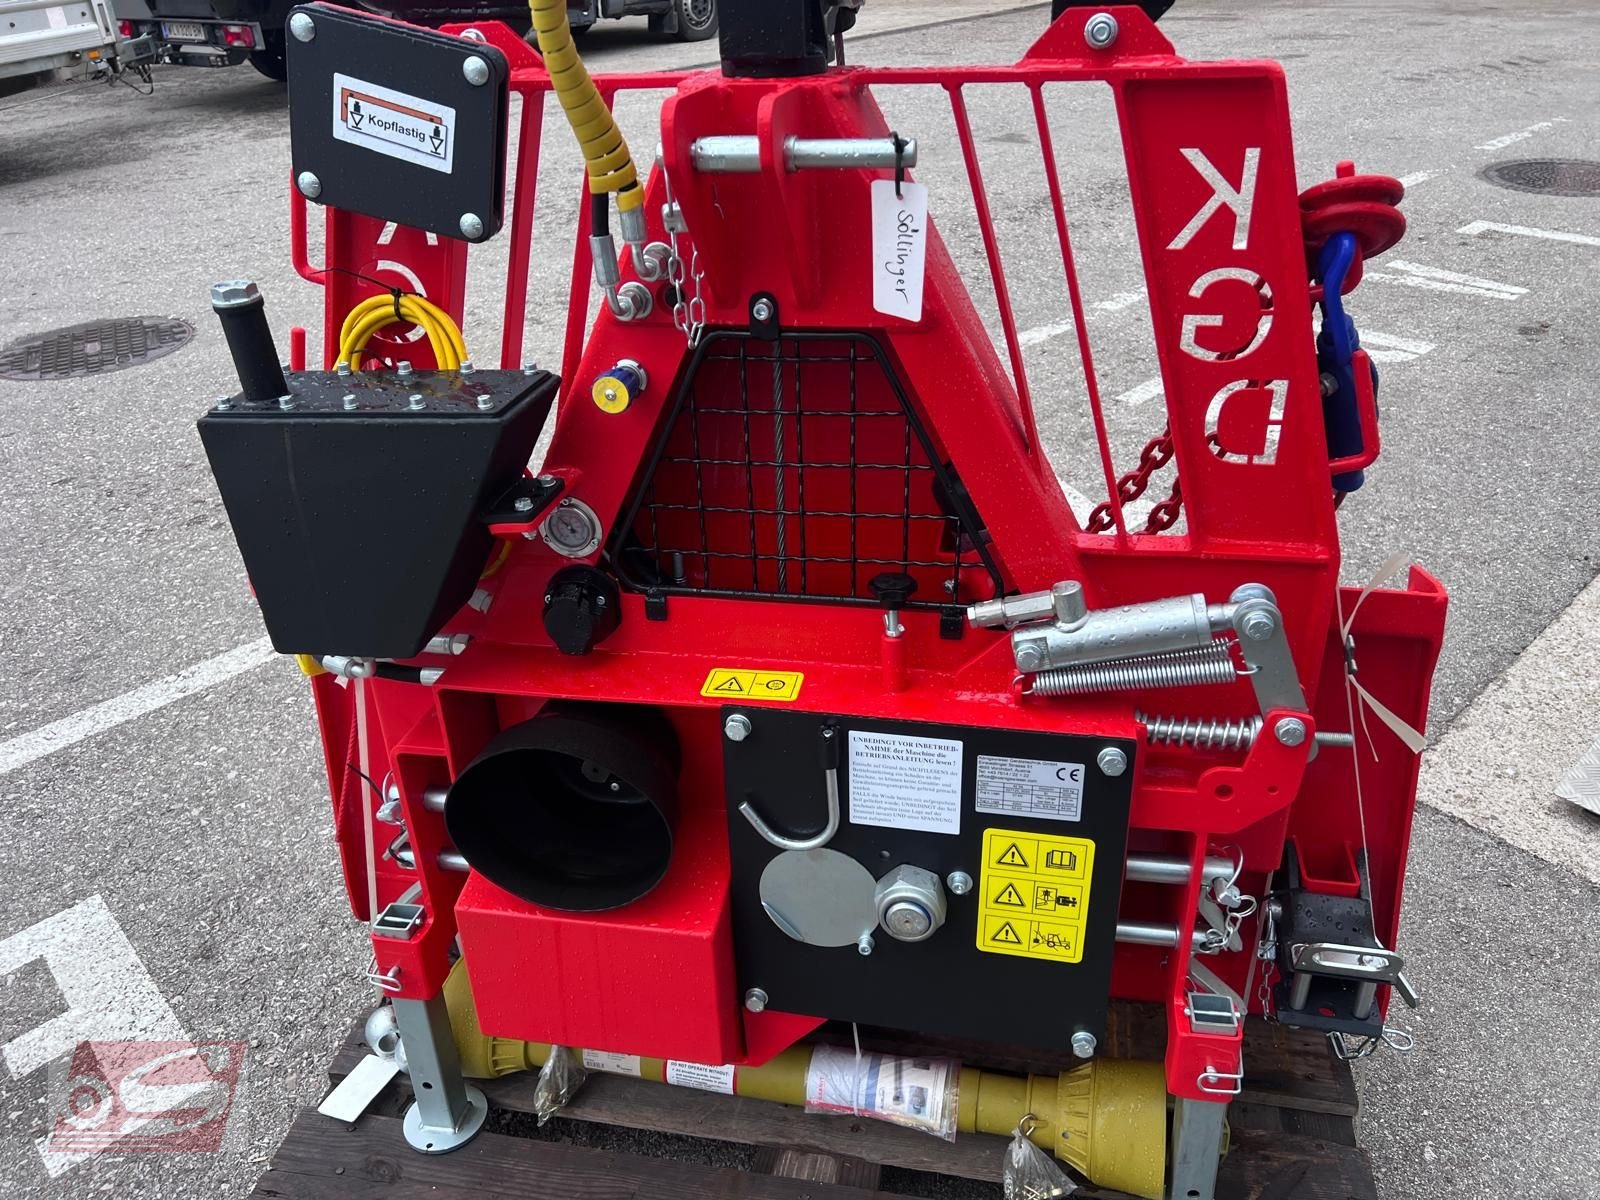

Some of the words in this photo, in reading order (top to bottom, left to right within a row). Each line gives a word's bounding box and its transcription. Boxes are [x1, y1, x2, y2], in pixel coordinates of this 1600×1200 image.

[368, 114, 426, 142] Kopflastig
[853, 736, 896, 746] UNBEDINGT
[864, 745, 891, 753] NAHME
[906, 749, 935, 757] Maschine
[856, 751, 934, 764] BETRIEBSANLEITUNG
